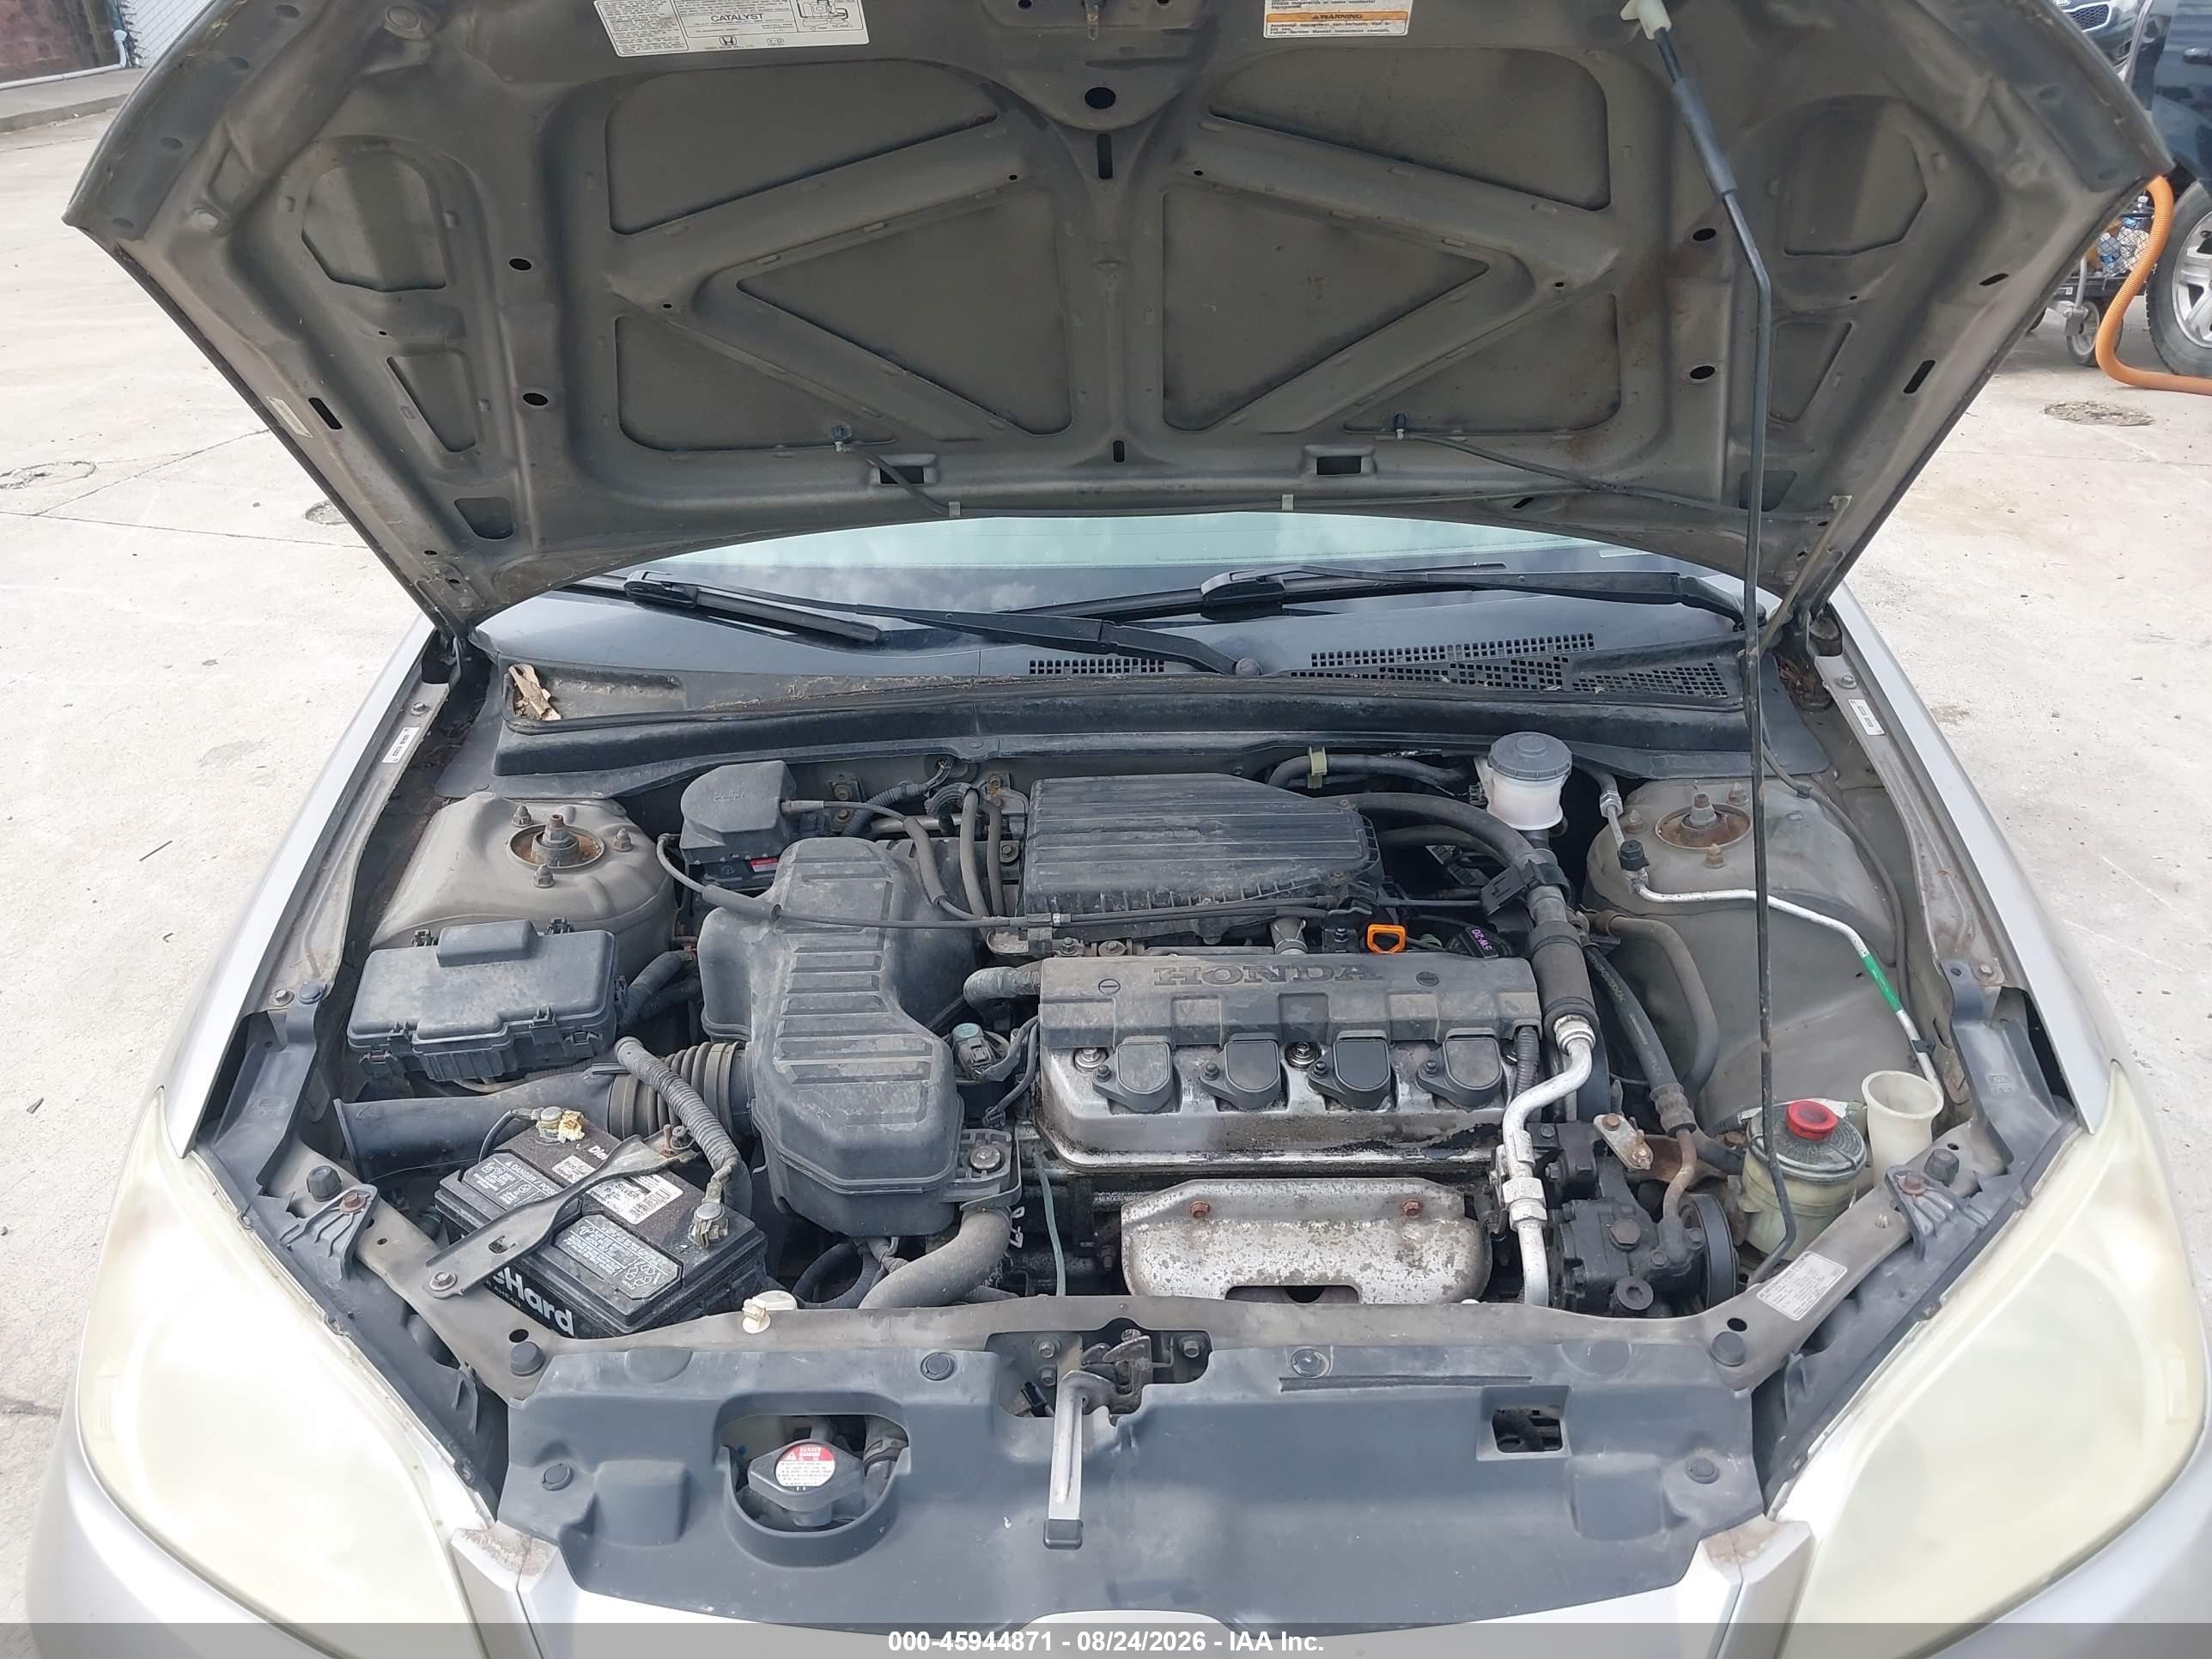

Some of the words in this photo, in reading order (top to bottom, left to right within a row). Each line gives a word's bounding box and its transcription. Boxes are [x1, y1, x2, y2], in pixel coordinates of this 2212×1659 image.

[710, 13, 763, 22] CATALYST
[1153, 963, 1382, 986] HONDA
[511, 1164, 538, 1183] DANGER
